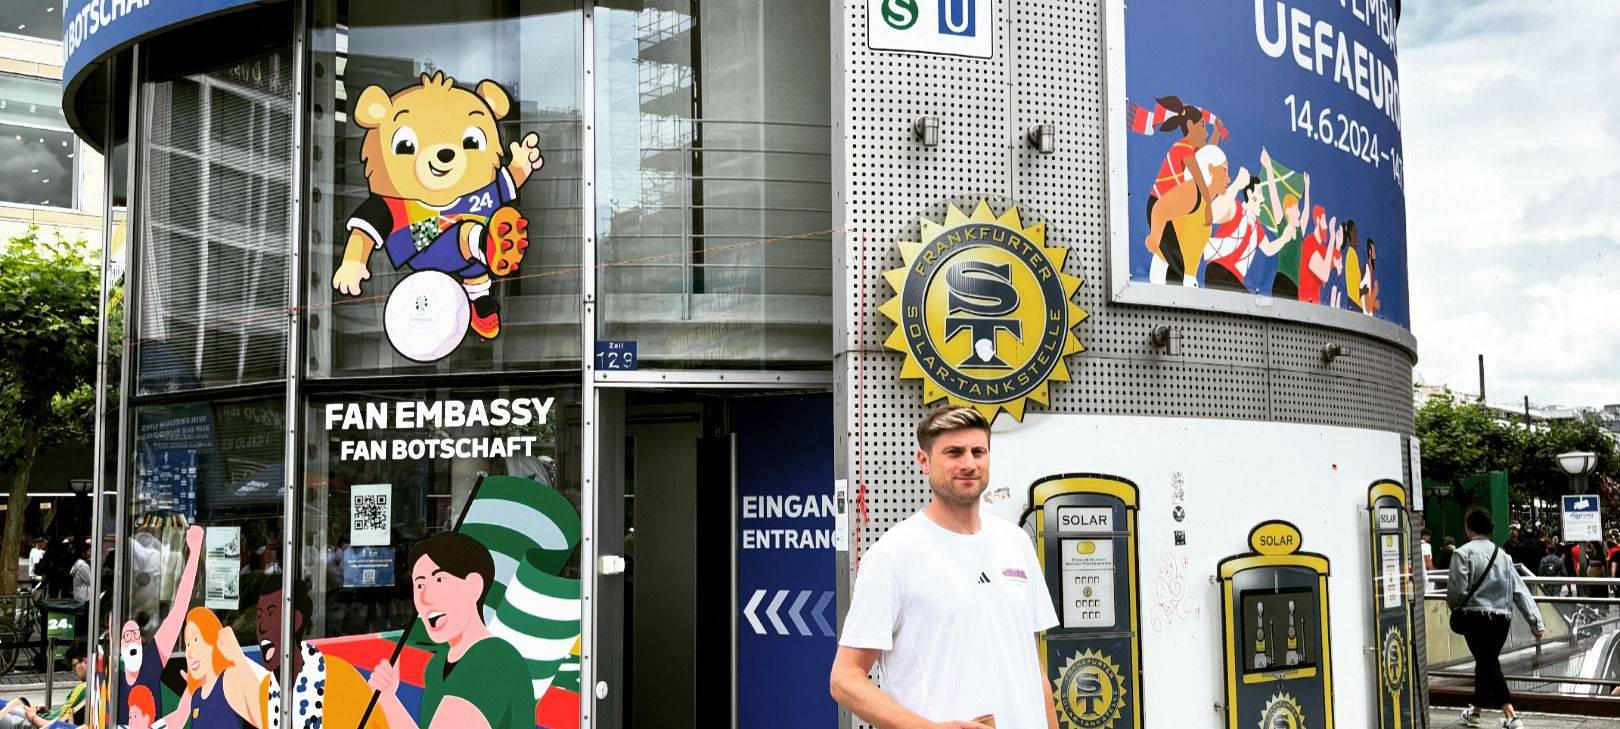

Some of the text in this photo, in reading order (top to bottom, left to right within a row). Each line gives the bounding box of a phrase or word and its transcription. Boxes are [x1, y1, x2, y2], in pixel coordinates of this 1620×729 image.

[69, 0, 150, 57] BOTSCH
[888, 0, 969, 33] S U
[469, 192, 494, 213] 24
[915, 227, 1052, 283] FRANKFURTER
[596, 352, 633, 369] 129
[907, 305, 1061, 396] SOLAR-TANKSTELLE
[325, 397, 554, 430] FAN EMBASSY
[340, 436, 536, 461] FAN BOTSCHAFT
[1062, 515, 1107, 526] SOLAR
[1380, 514, 1397, 524] SOLAR
[1259, 535, 1293, 546] SOLAR
